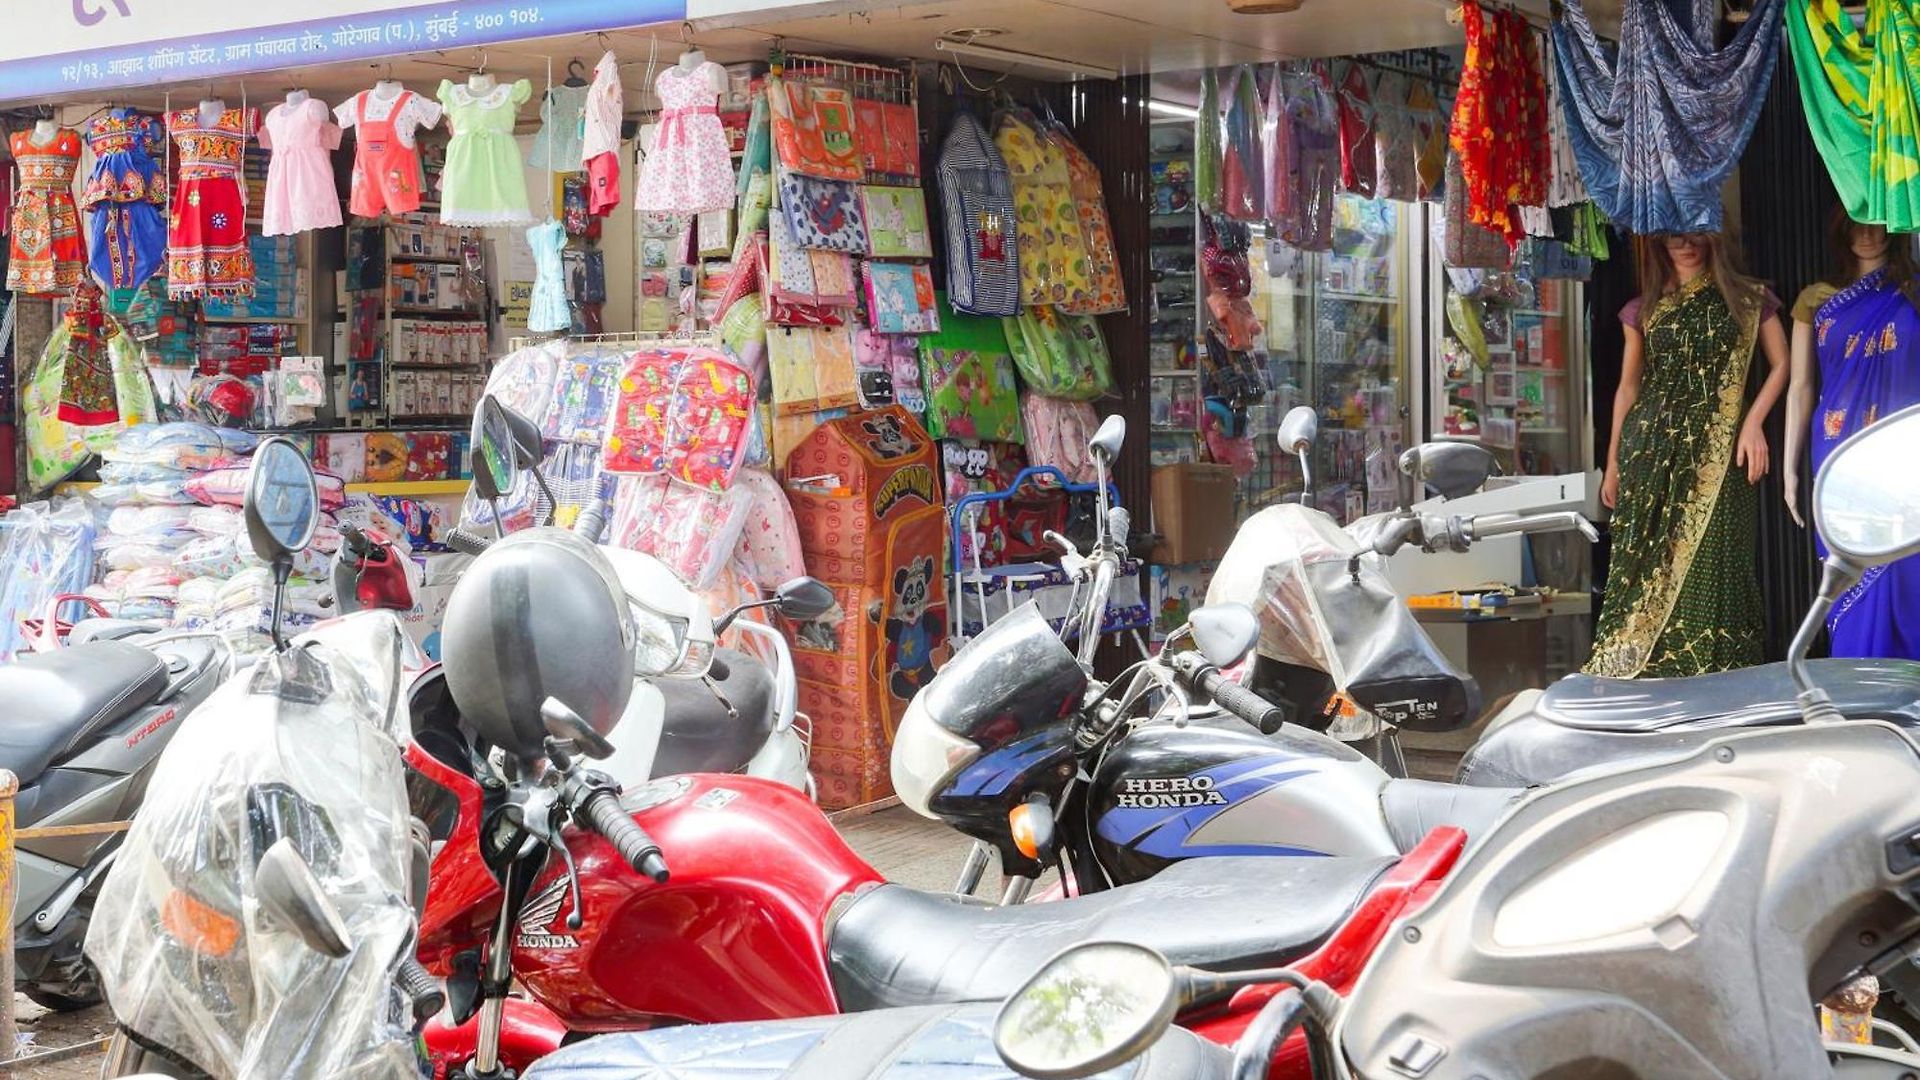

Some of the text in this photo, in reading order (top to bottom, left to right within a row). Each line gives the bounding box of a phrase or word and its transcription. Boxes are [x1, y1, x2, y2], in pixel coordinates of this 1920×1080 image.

[61, 61, 104, 83] १२/१३,
[107, 56, 144, 77] आझाद
[148, 47, 184, 70] शॉपिंग
[188, 43, 221, 65] सेंटर,
[225, 43, 251, 61] ग्राम
[254, 35, 297, 57] पंचायत
[332, 24, 381, 48] गोरेगाव
[386, 19, 421, 44] (प.),
[425, 10, 460, 42] मुंबई
[474, 13, 504, 30] ४००
[509, 7, 544, 26] १०४.
[1125, 776, 1214, 793] HERO
[1117, 791, 1228, 808] HONDA
[517, 934, 580, 948] HONDA
